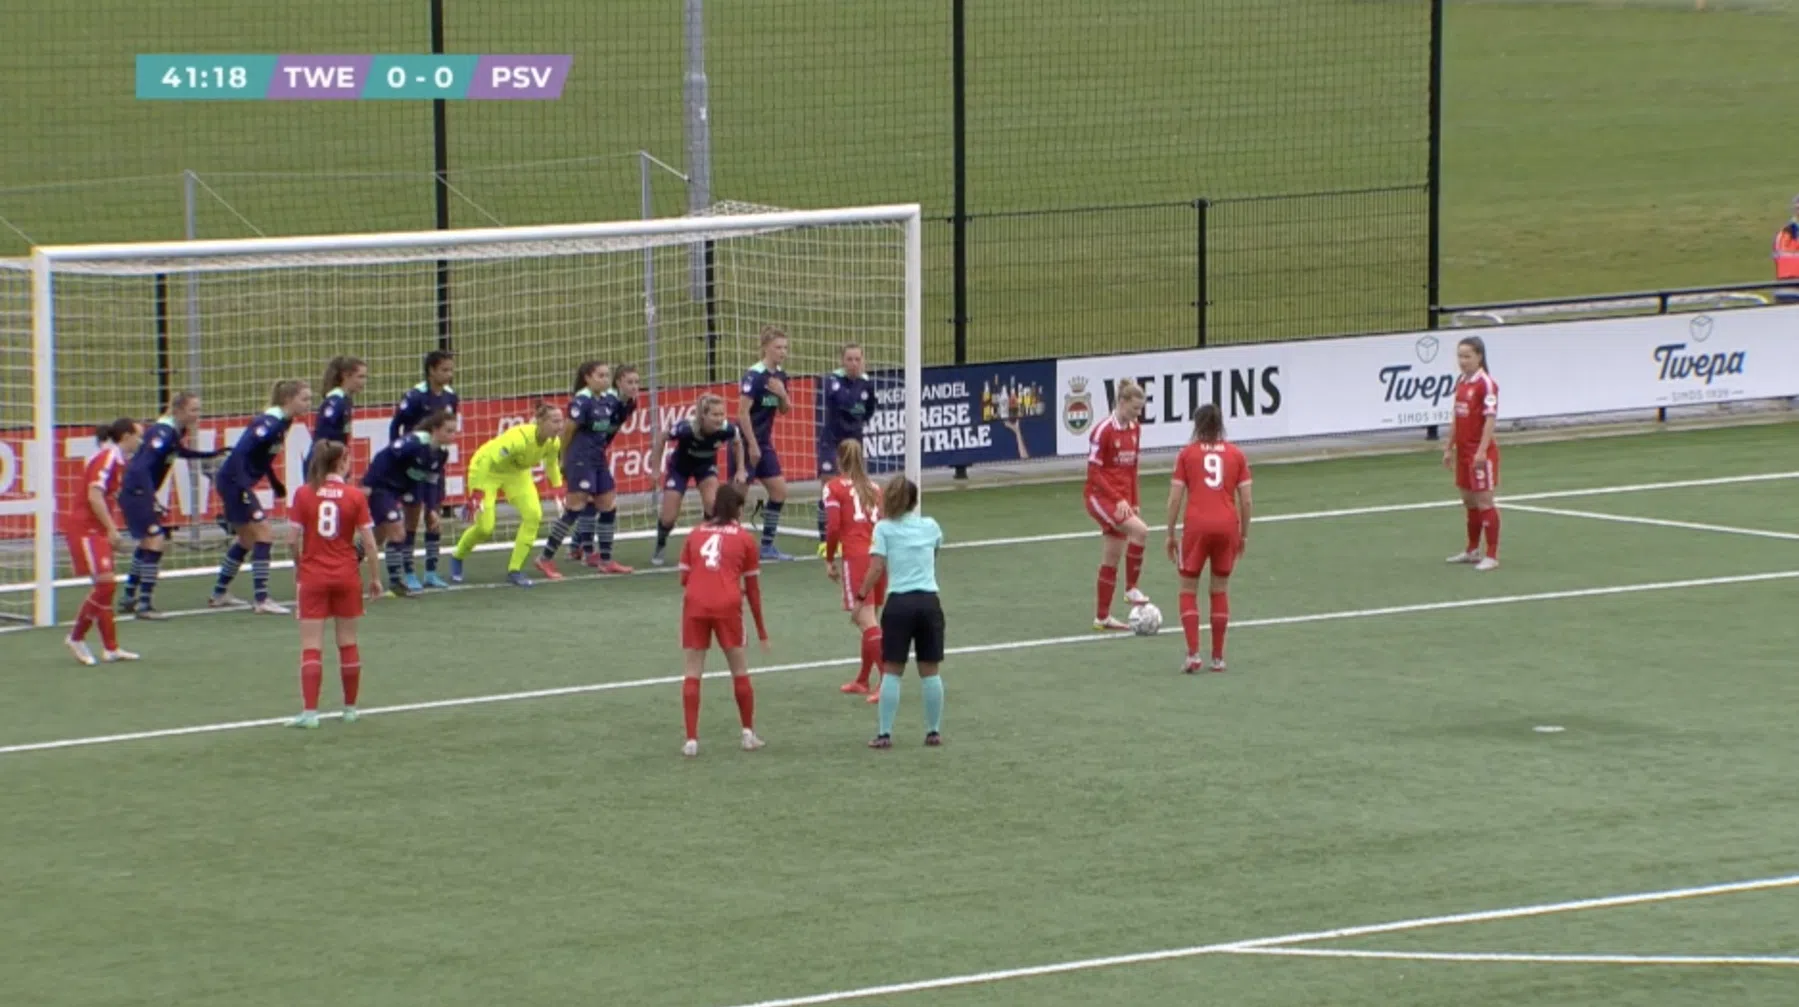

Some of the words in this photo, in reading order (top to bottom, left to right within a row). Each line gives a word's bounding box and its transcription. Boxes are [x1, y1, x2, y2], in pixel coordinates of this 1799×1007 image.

[1654, 343, 1745, 384] Twepa
[1379, 365, 1456, 406] Twep
[1203, 453, 1222, 489] 9
[317, 500, 339, 538] 8
[849, 486, 878, 524] 1
[699, 533, 721, 569] 4
